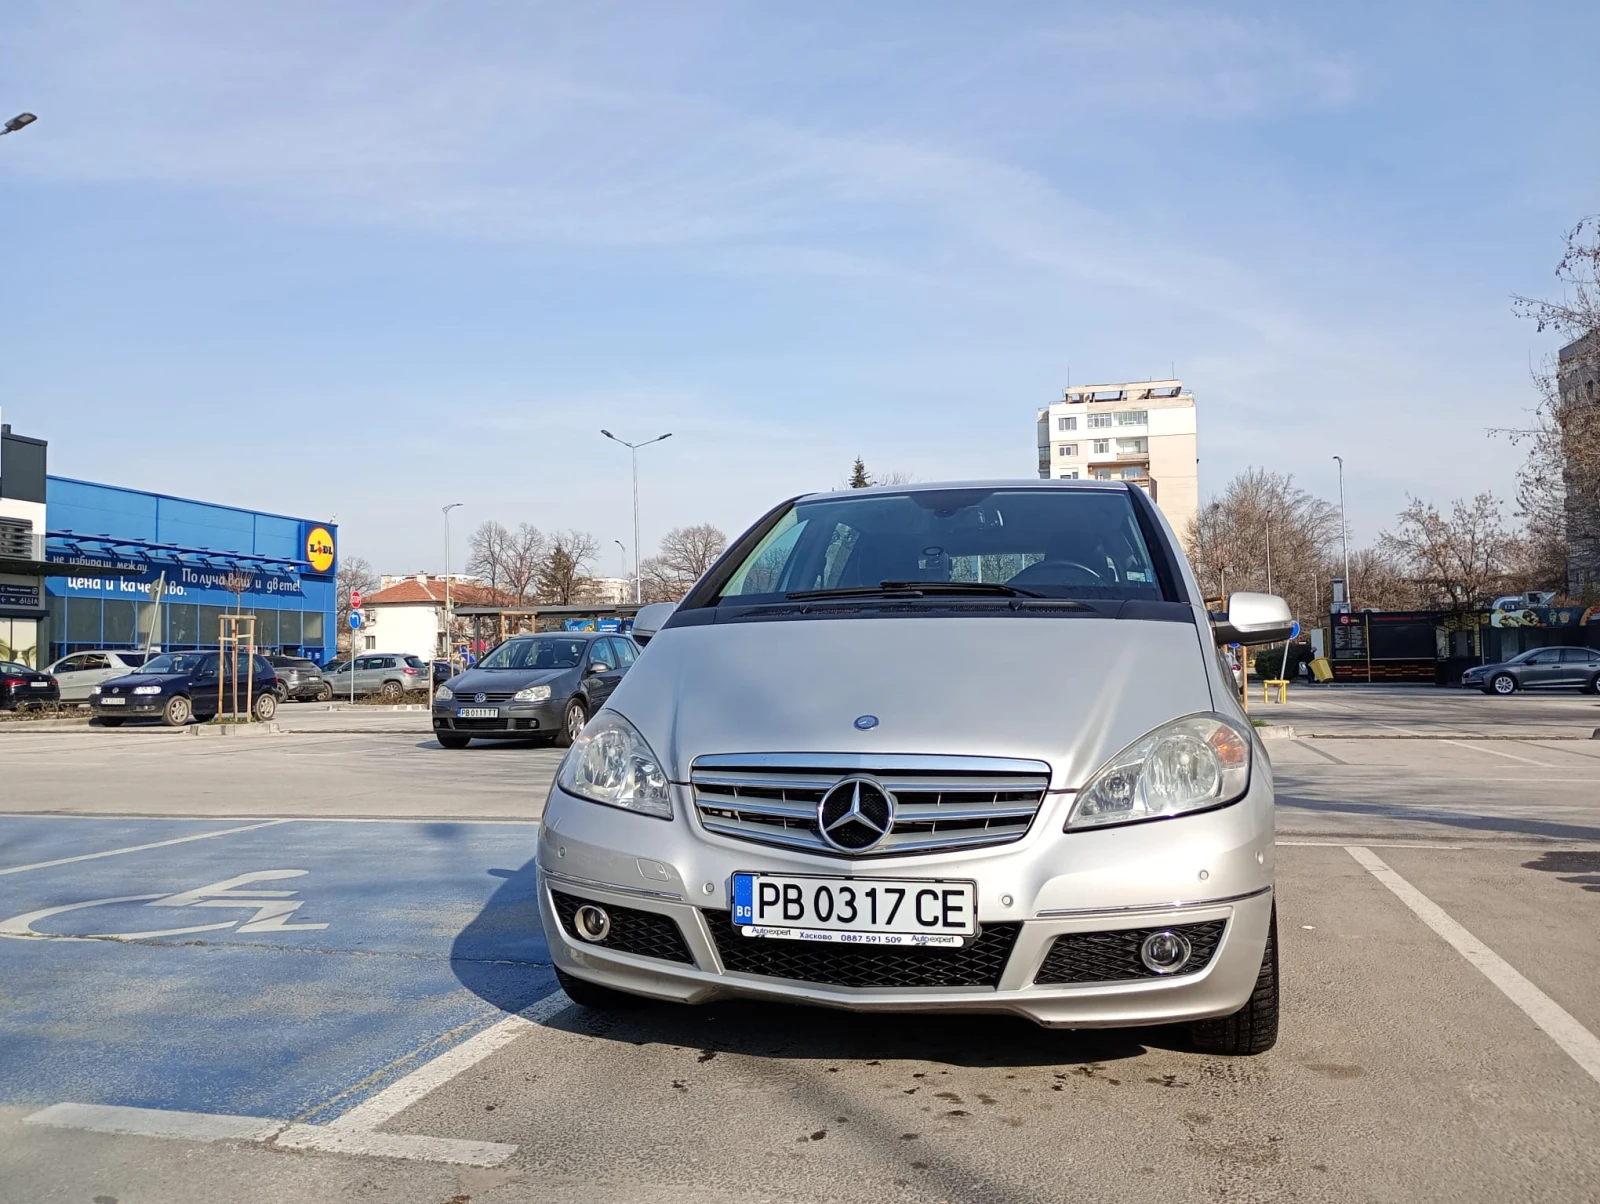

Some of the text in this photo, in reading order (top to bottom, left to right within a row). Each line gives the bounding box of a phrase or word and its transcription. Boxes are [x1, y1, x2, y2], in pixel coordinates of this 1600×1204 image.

[53, 555, 64, 564] не
[67, 575, 187, 596] цена и качево.
[182, 567, 300, 593] Получаваш и двете!
[736, 905, 752, 917] BG
[758, 882, 967, 928] PB 0317 CE
[799, 931, 833, 941] Хасково
[840, 934, 863, 942] 0887
[865, 935, 882, 943] 591
